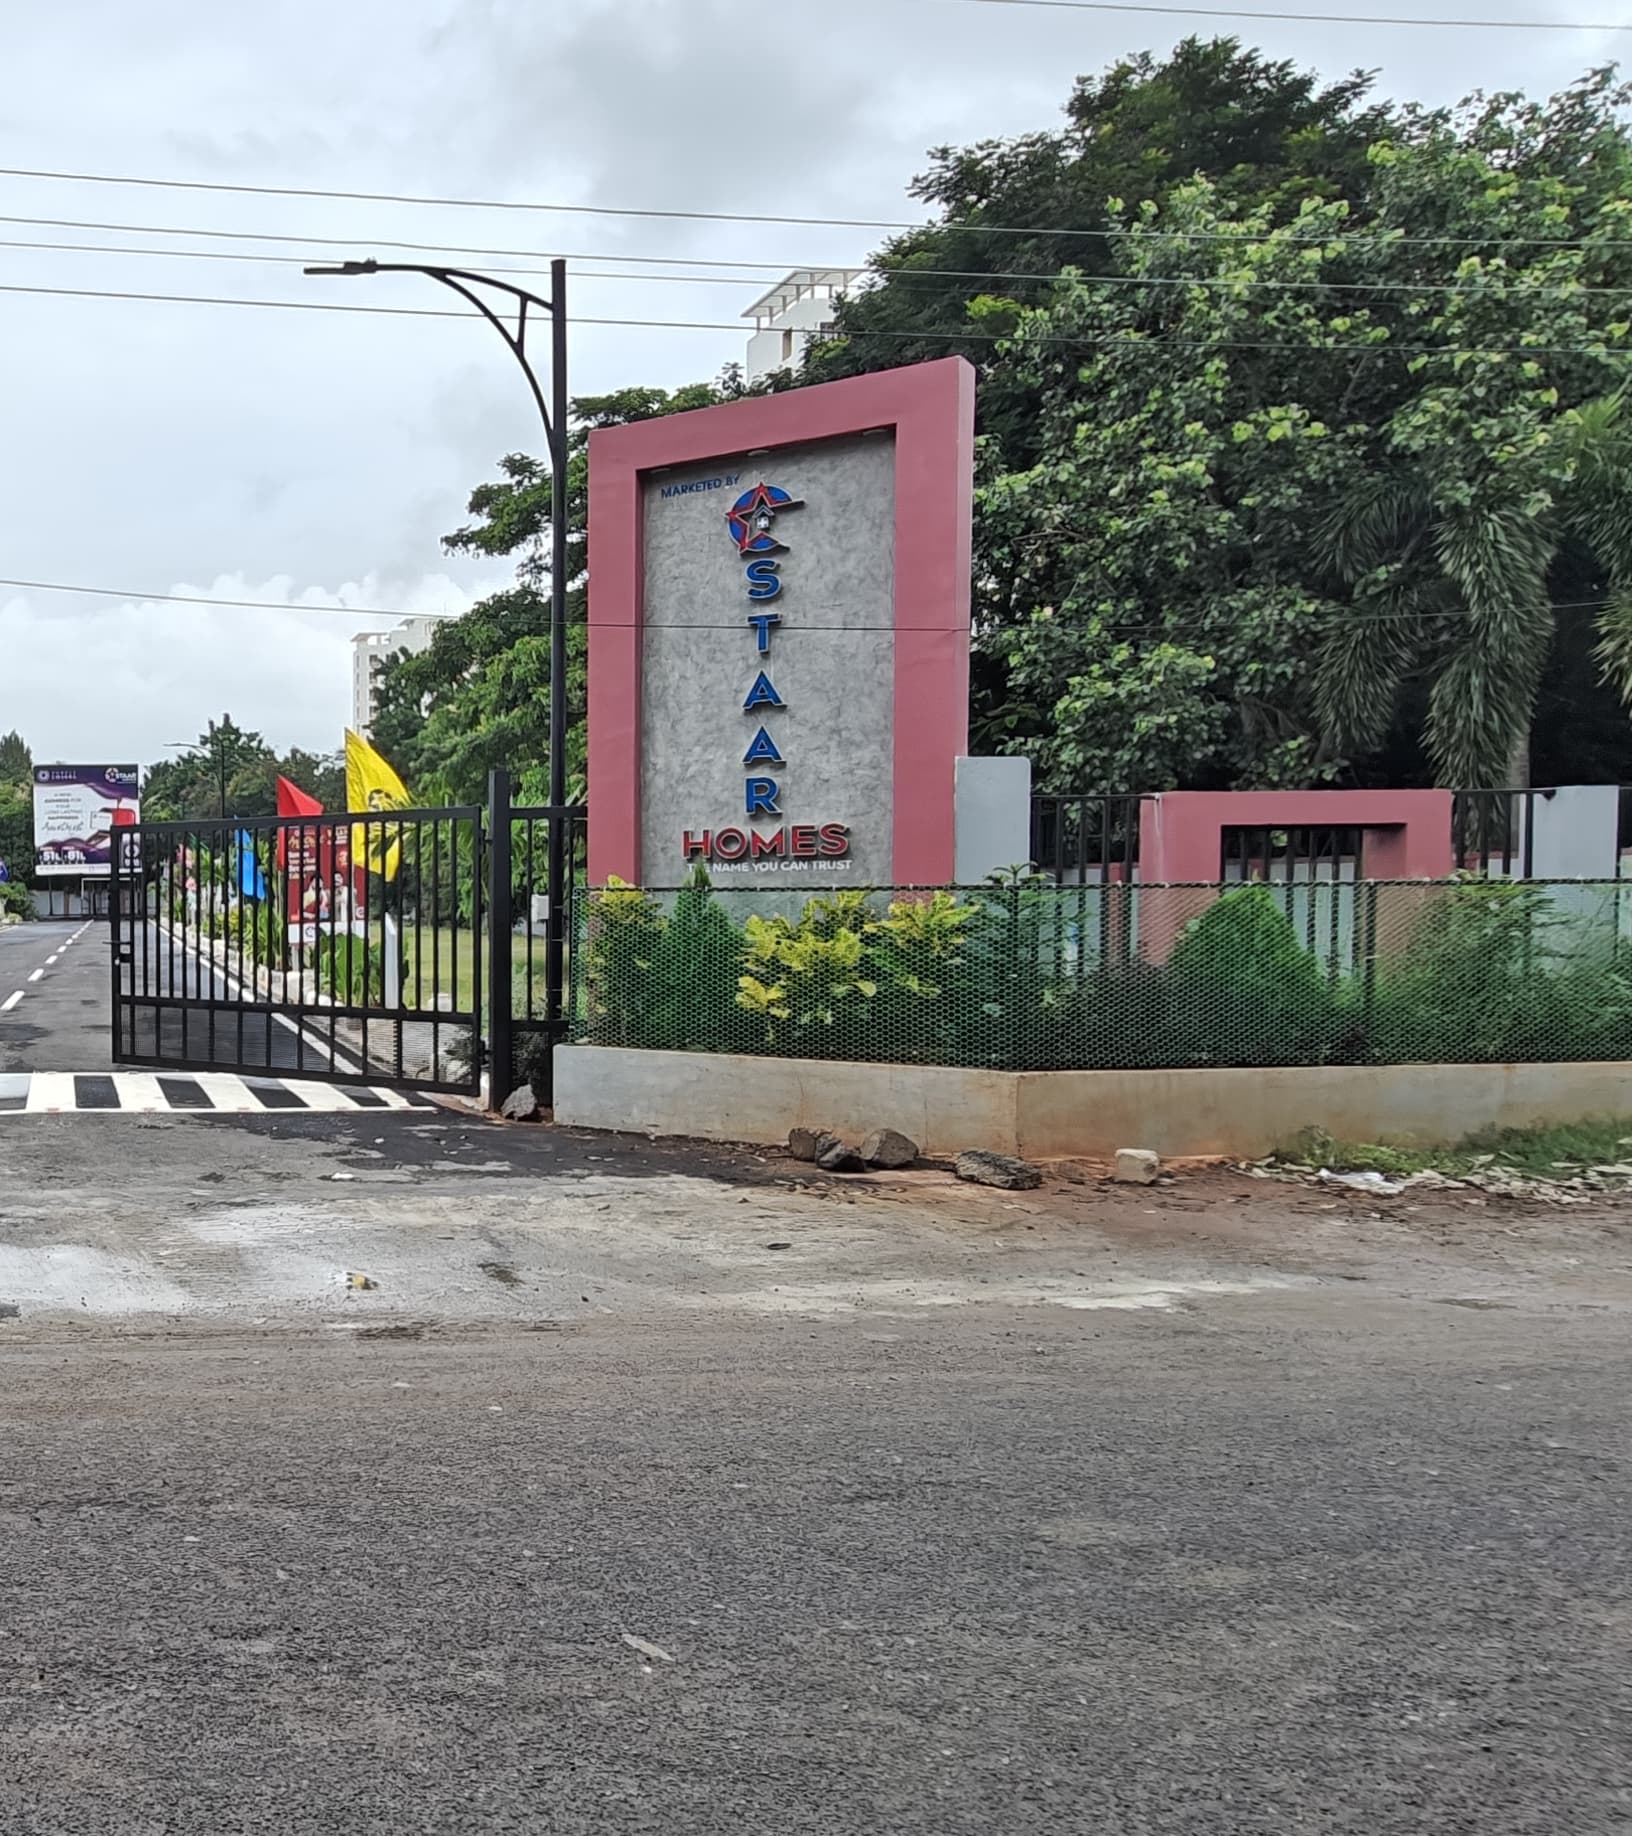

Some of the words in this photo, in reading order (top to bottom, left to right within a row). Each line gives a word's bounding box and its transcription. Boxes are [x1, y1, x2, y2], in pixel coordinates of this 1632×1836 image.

[661, 479, 722, 498] MARKETED
[723, 473, 741, 488] BY
[742, 558, 789, 818] STAAR
[681, 822, 850, 860] HOMES
[687, 862, 711, 873] TE
[712, 862, 750, 873] NAME
[752, 861, 779, 873] YOU
[780, 861, 808, 871] CAN
[811, 859, 853, 870] TRUST
